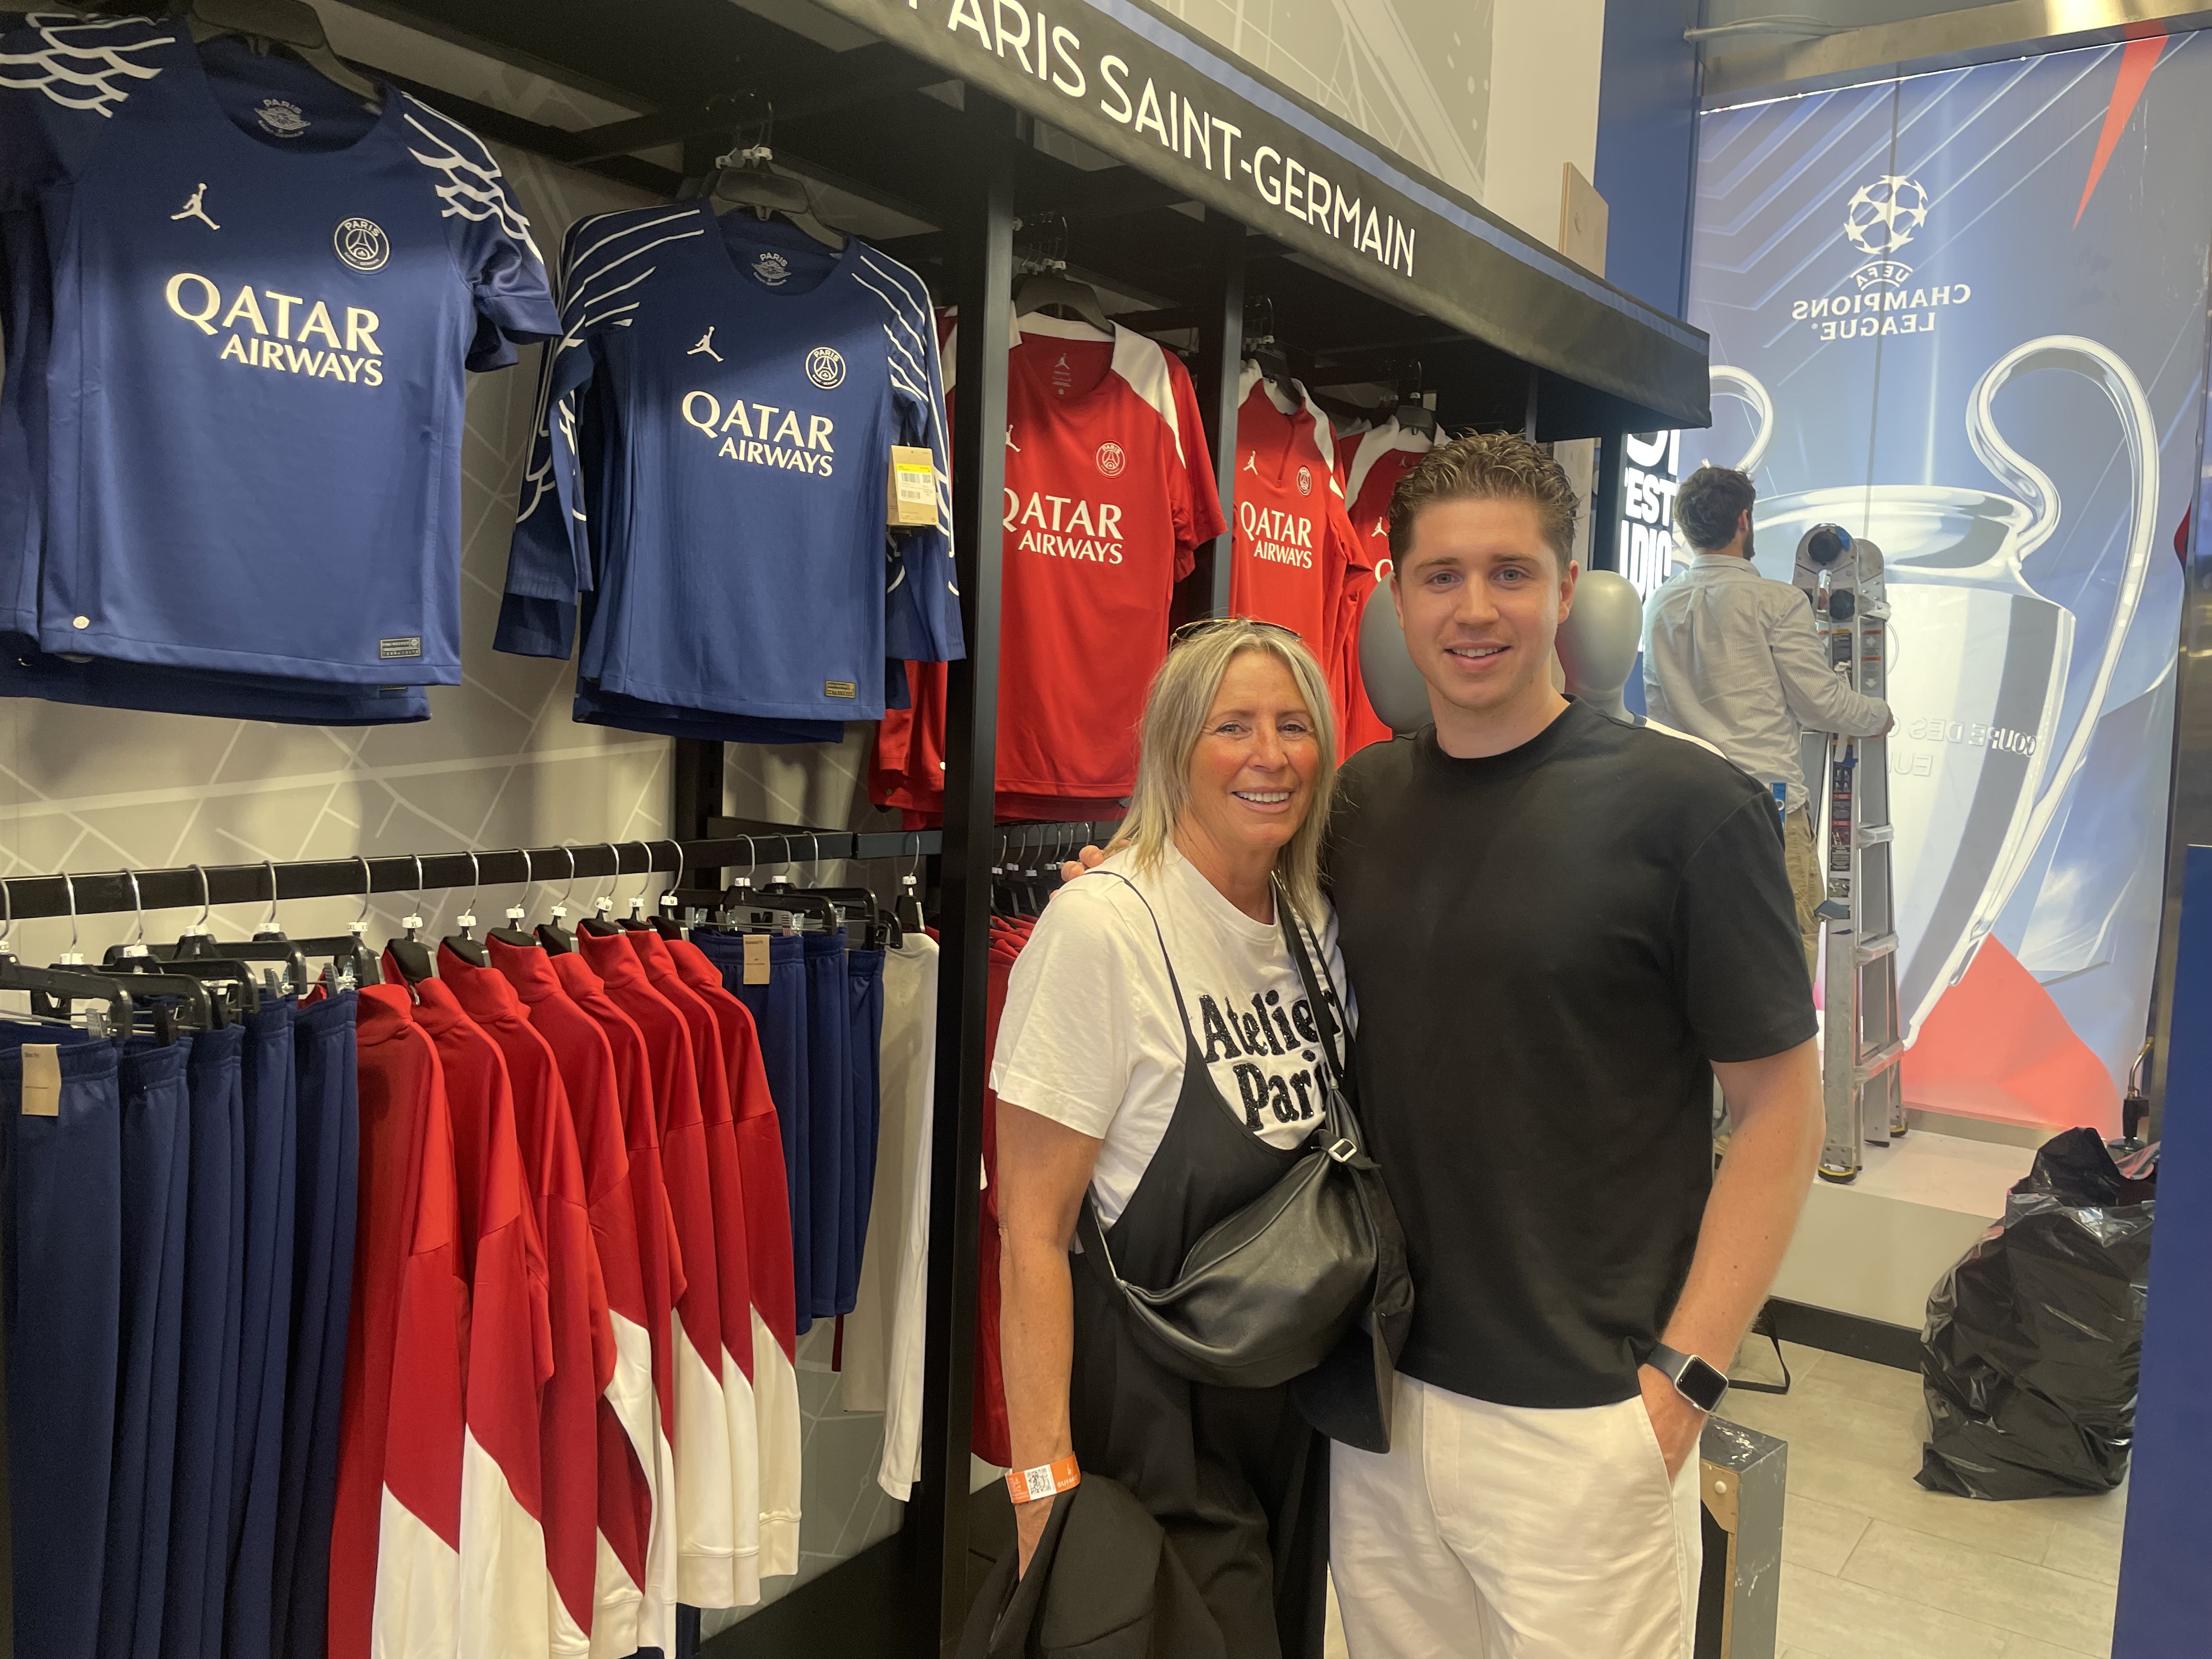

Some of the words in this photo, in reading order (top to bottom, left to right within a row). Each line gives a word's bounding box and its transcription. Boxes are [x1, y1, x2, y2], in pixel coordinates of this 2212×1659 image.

[908, 0, 1086, 98] ARIS
[1099, 55, 1415, 277] SAINT-GERMAIN
[344, 221, 381, 236] PARIS
[759, 252, 788, 267] PARIS
[166, 273, 383, 356] QATAR
[221, 334, 383, 386] AIRWAYS
[813, 349, 839, 362] PARIS
[682, 391, 834, 453] QATAR
[718, 437, 833, 477] AIRWAYS
[1624, 467, 1677, 527] 'EST
[1018, 529, 1123, 565] AIRWAYS
[1240, 501, 1313, 549] QATAR
[1254, 539, 1312, 569] AIRWAYS
[1232, 1049, 1327, 1132] Pari
